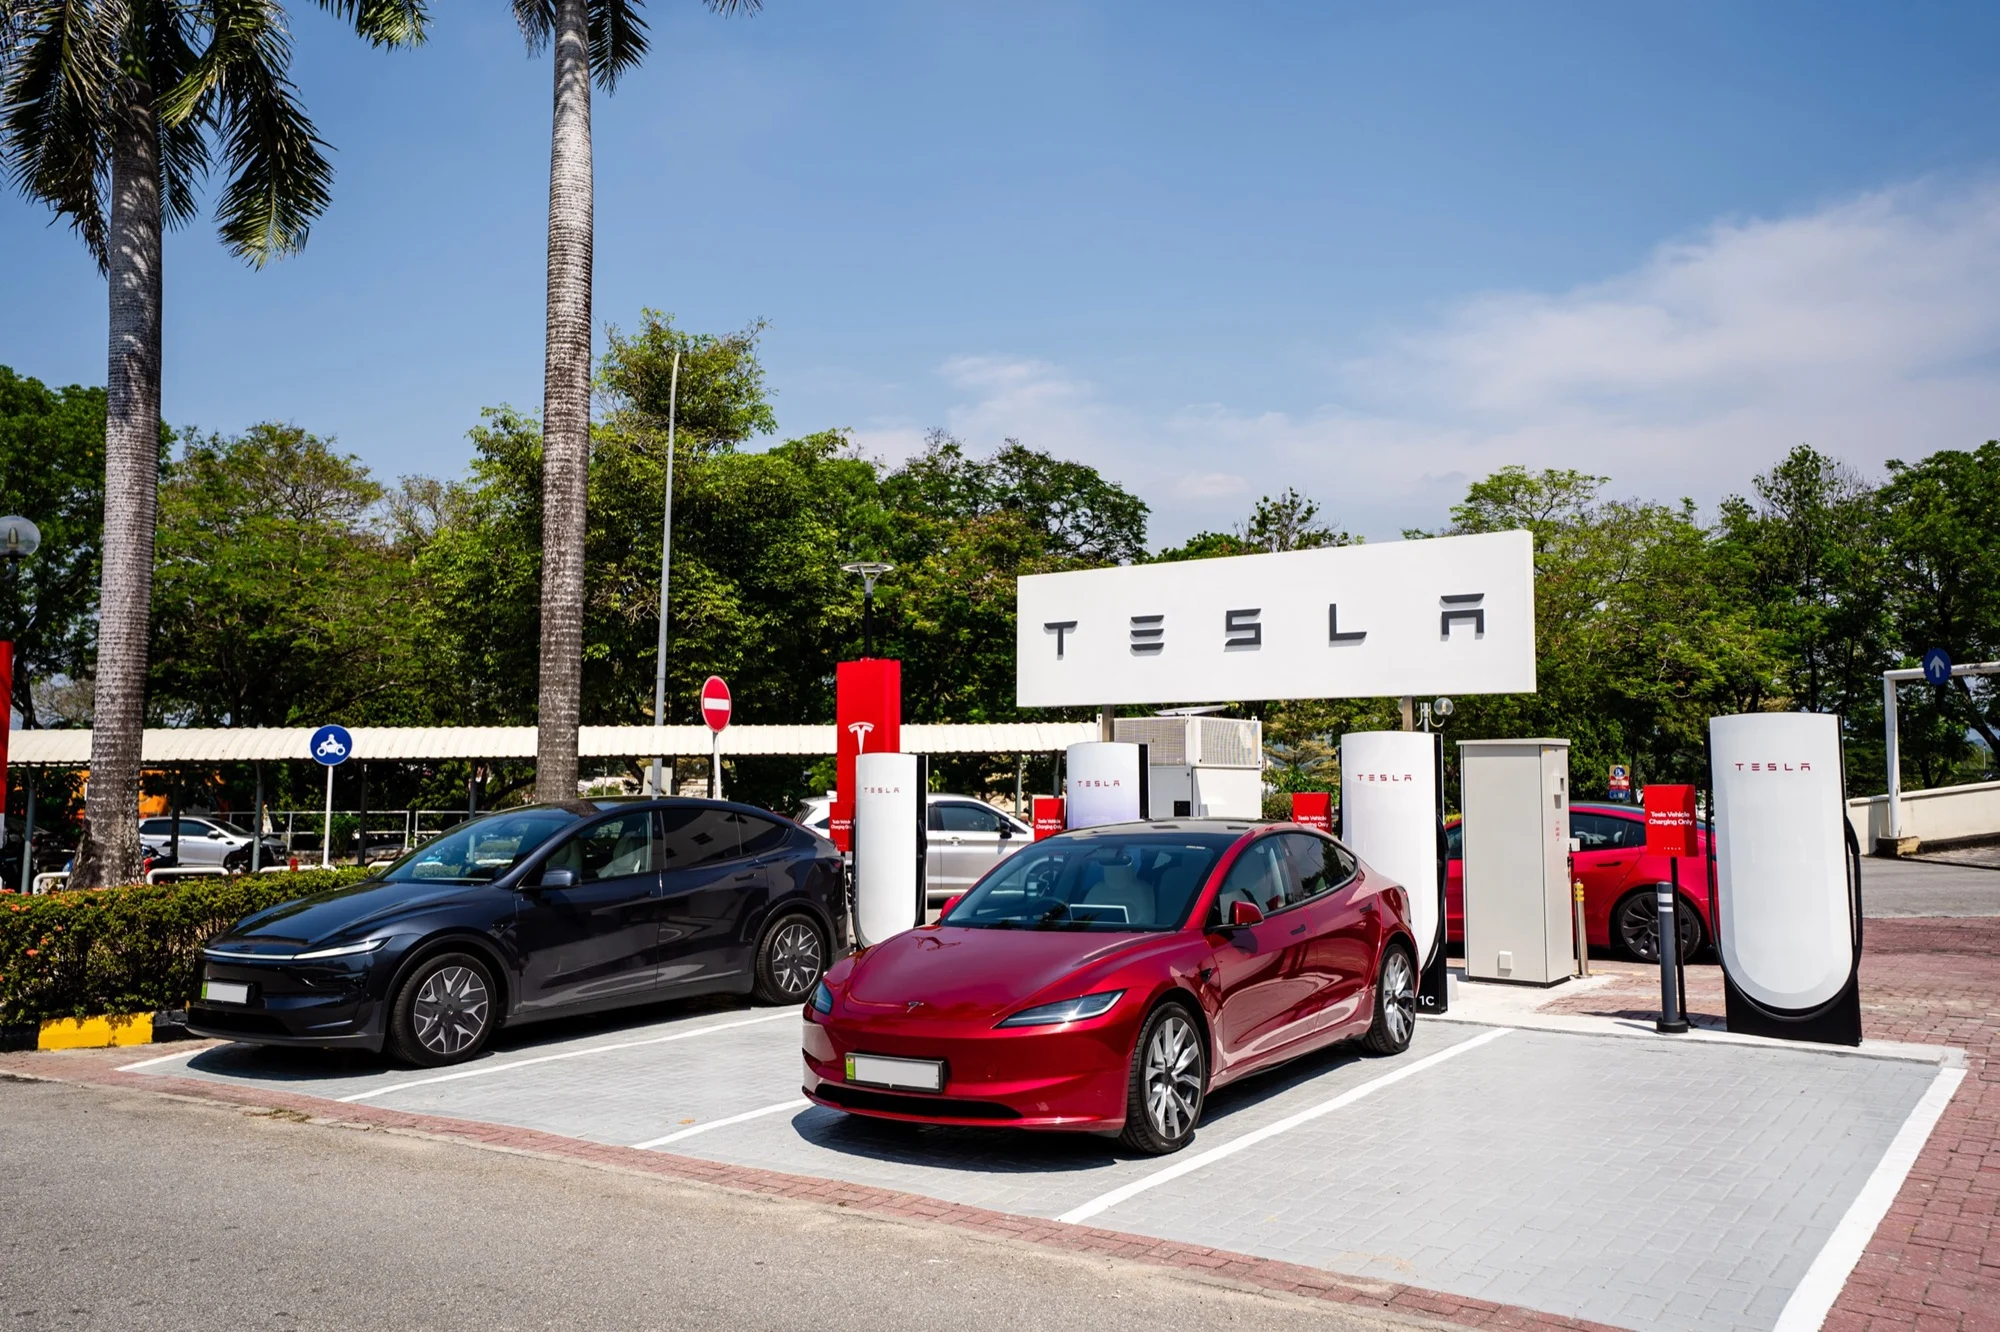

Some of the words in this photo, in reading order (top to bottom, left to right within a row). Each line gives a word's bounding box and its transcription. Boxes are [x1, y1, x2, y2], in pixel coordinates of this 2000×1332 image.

[1043, 593, 1485, 657] TESLA
[1735, 763, 1810, 771] TESLA
[1419, 995, 1435, 1006] 1C
